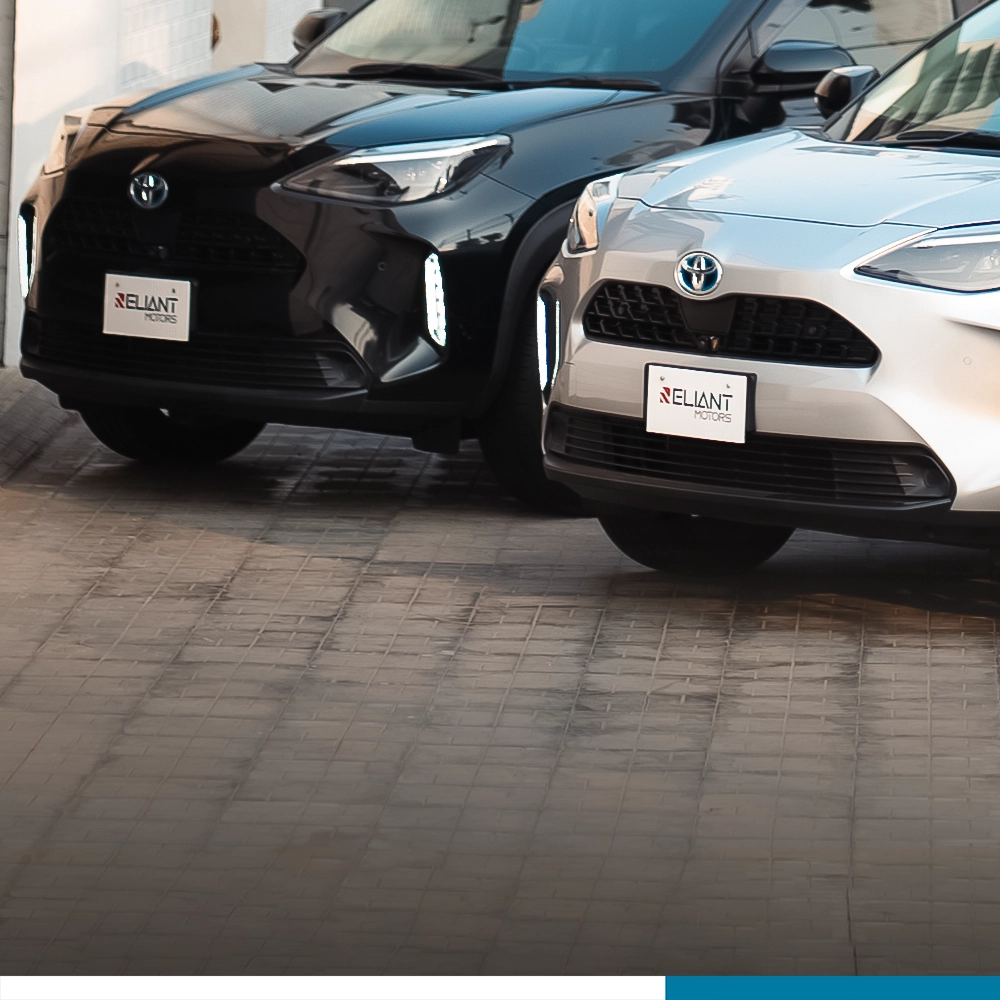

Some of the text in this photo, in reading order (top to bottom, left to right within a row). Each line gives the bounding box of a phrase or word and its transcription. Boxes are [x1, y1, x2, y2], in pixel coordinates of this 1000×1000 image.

[114, 292, 179, 313] RELIANT
[144, 312, 178, 324] MOTORS
[659, 386, 733, 411] RELIANT
[694, 410, 732, 423] MOTORS
